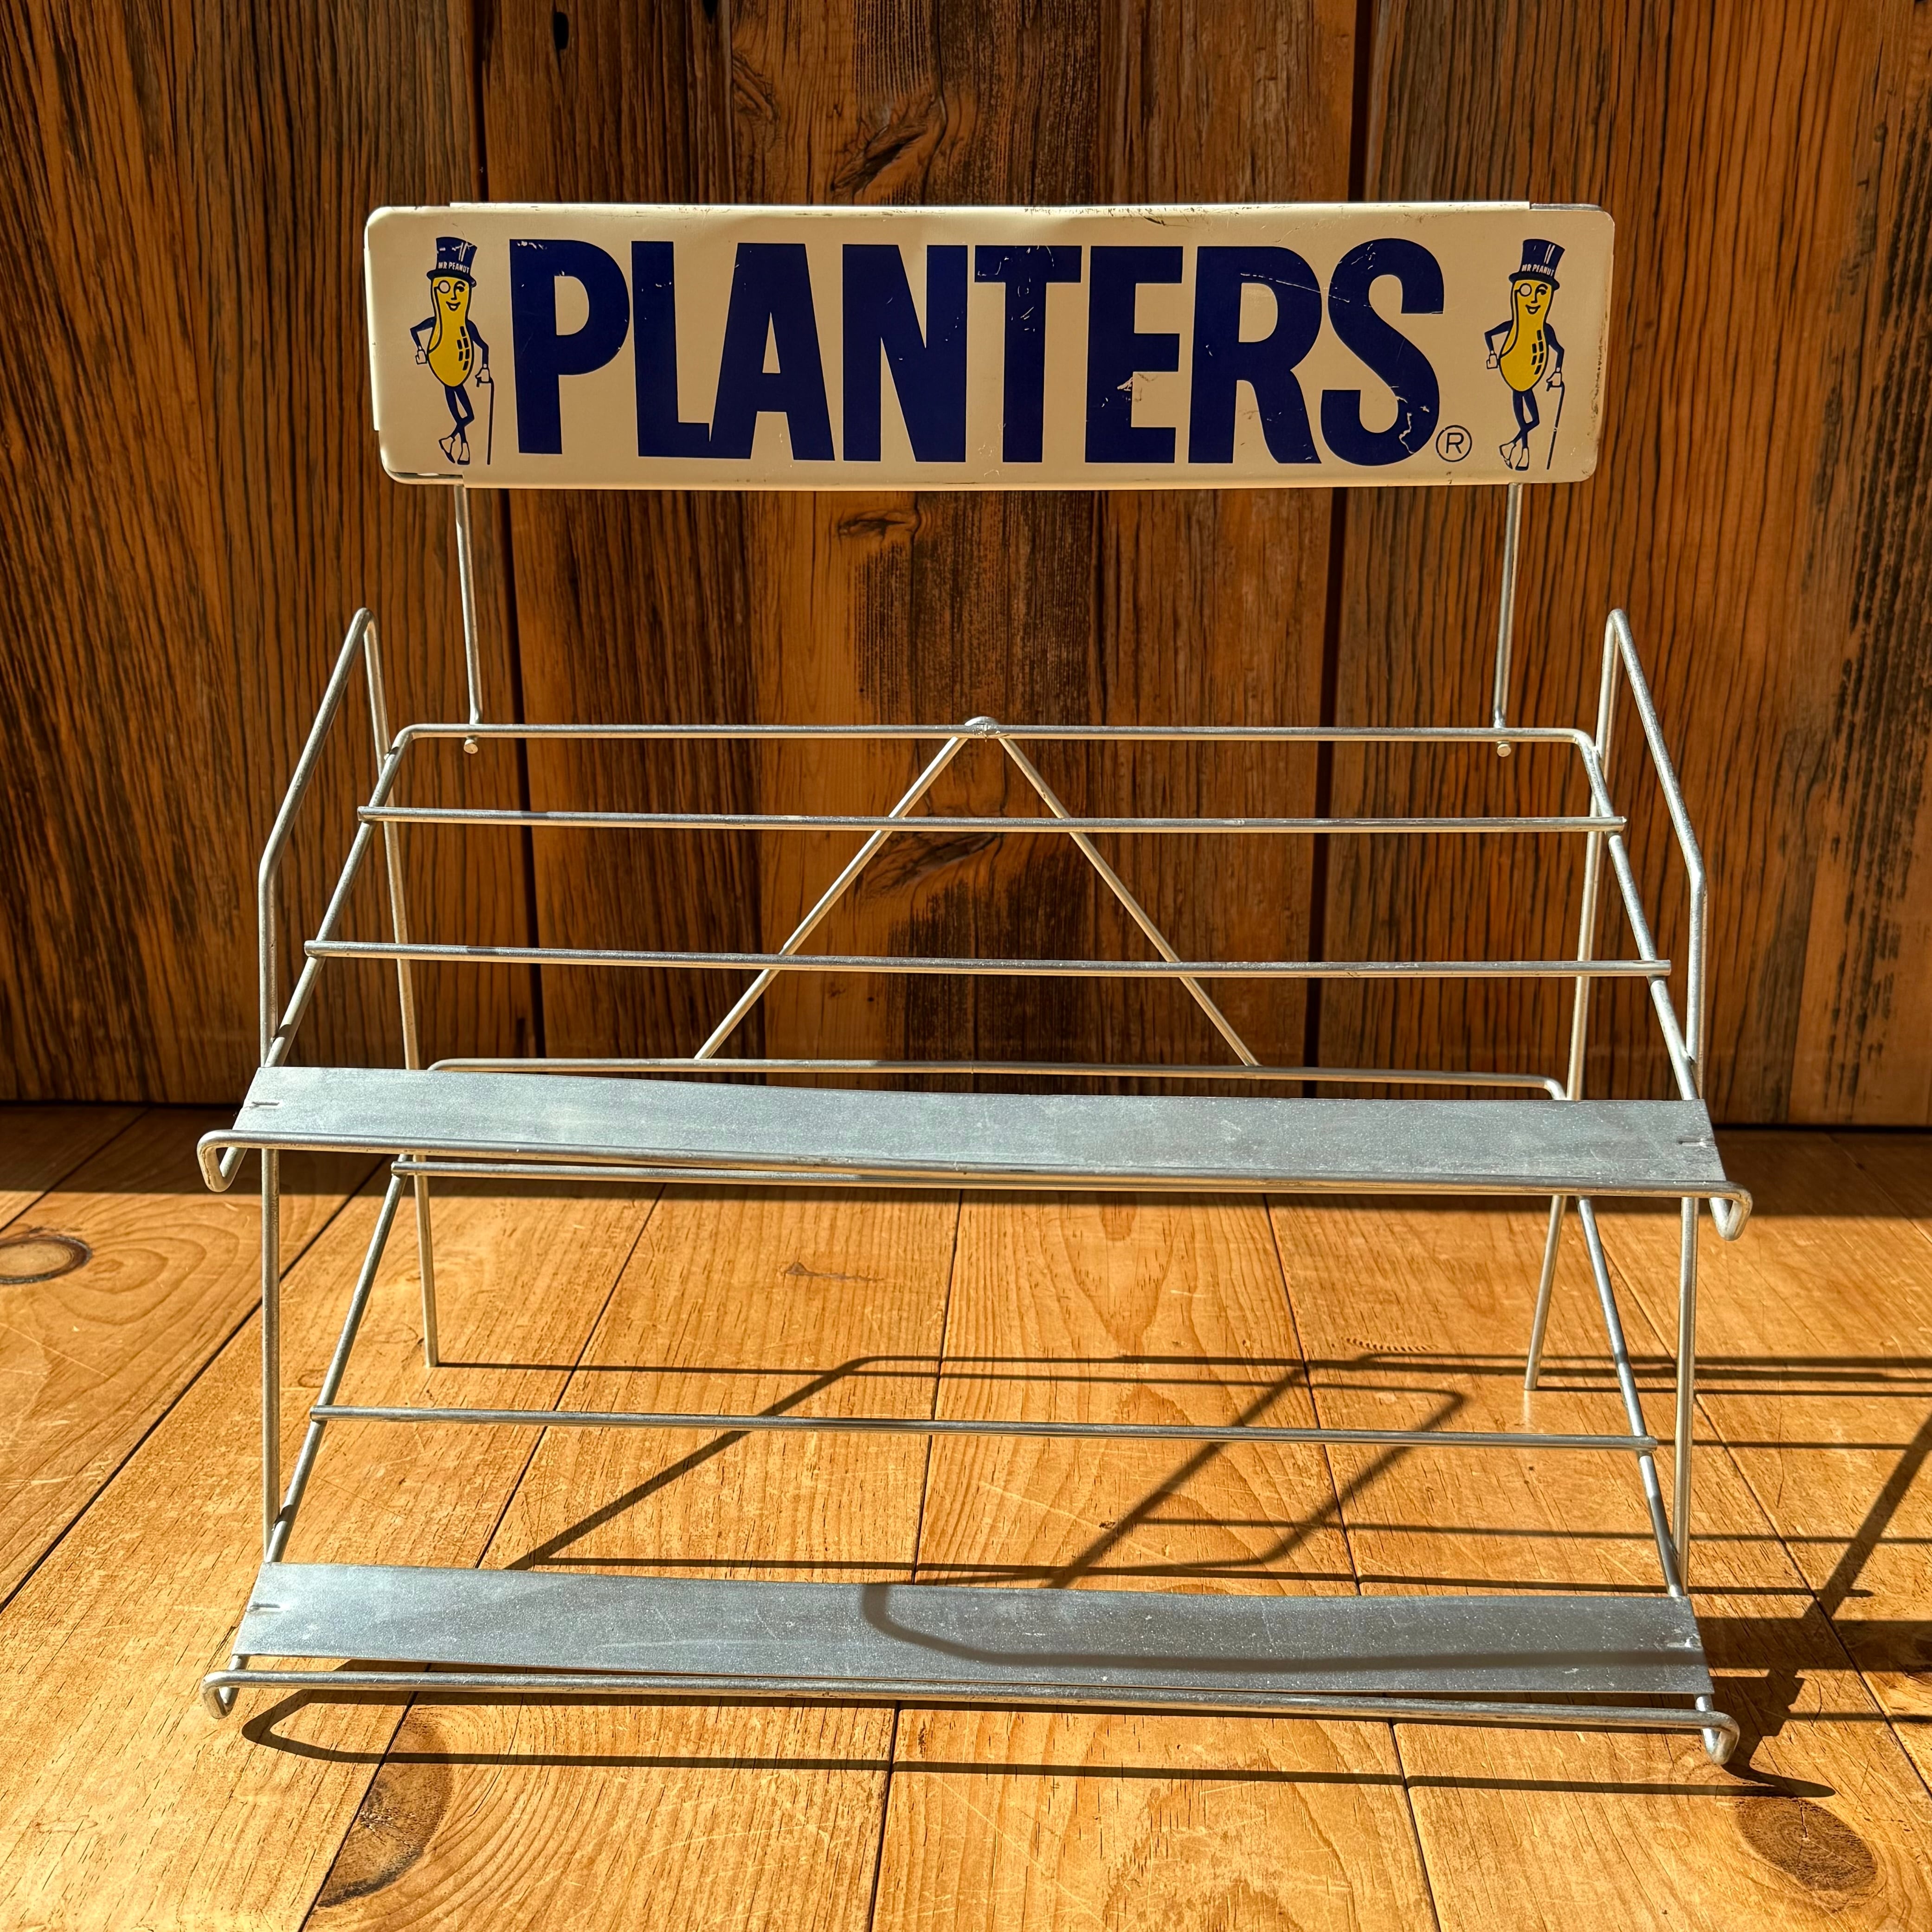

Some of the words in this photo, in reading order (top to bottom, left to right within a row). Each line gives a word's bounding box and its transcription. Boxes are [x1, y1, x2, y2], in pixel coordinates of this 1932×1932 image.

[448, 261, 470, 274] PEANUT
[1521, 264, 1532, 272] MR
[1532, 264, 1554, 277] PEANUT
[509, 238, 1444, 466] PLANTERS
